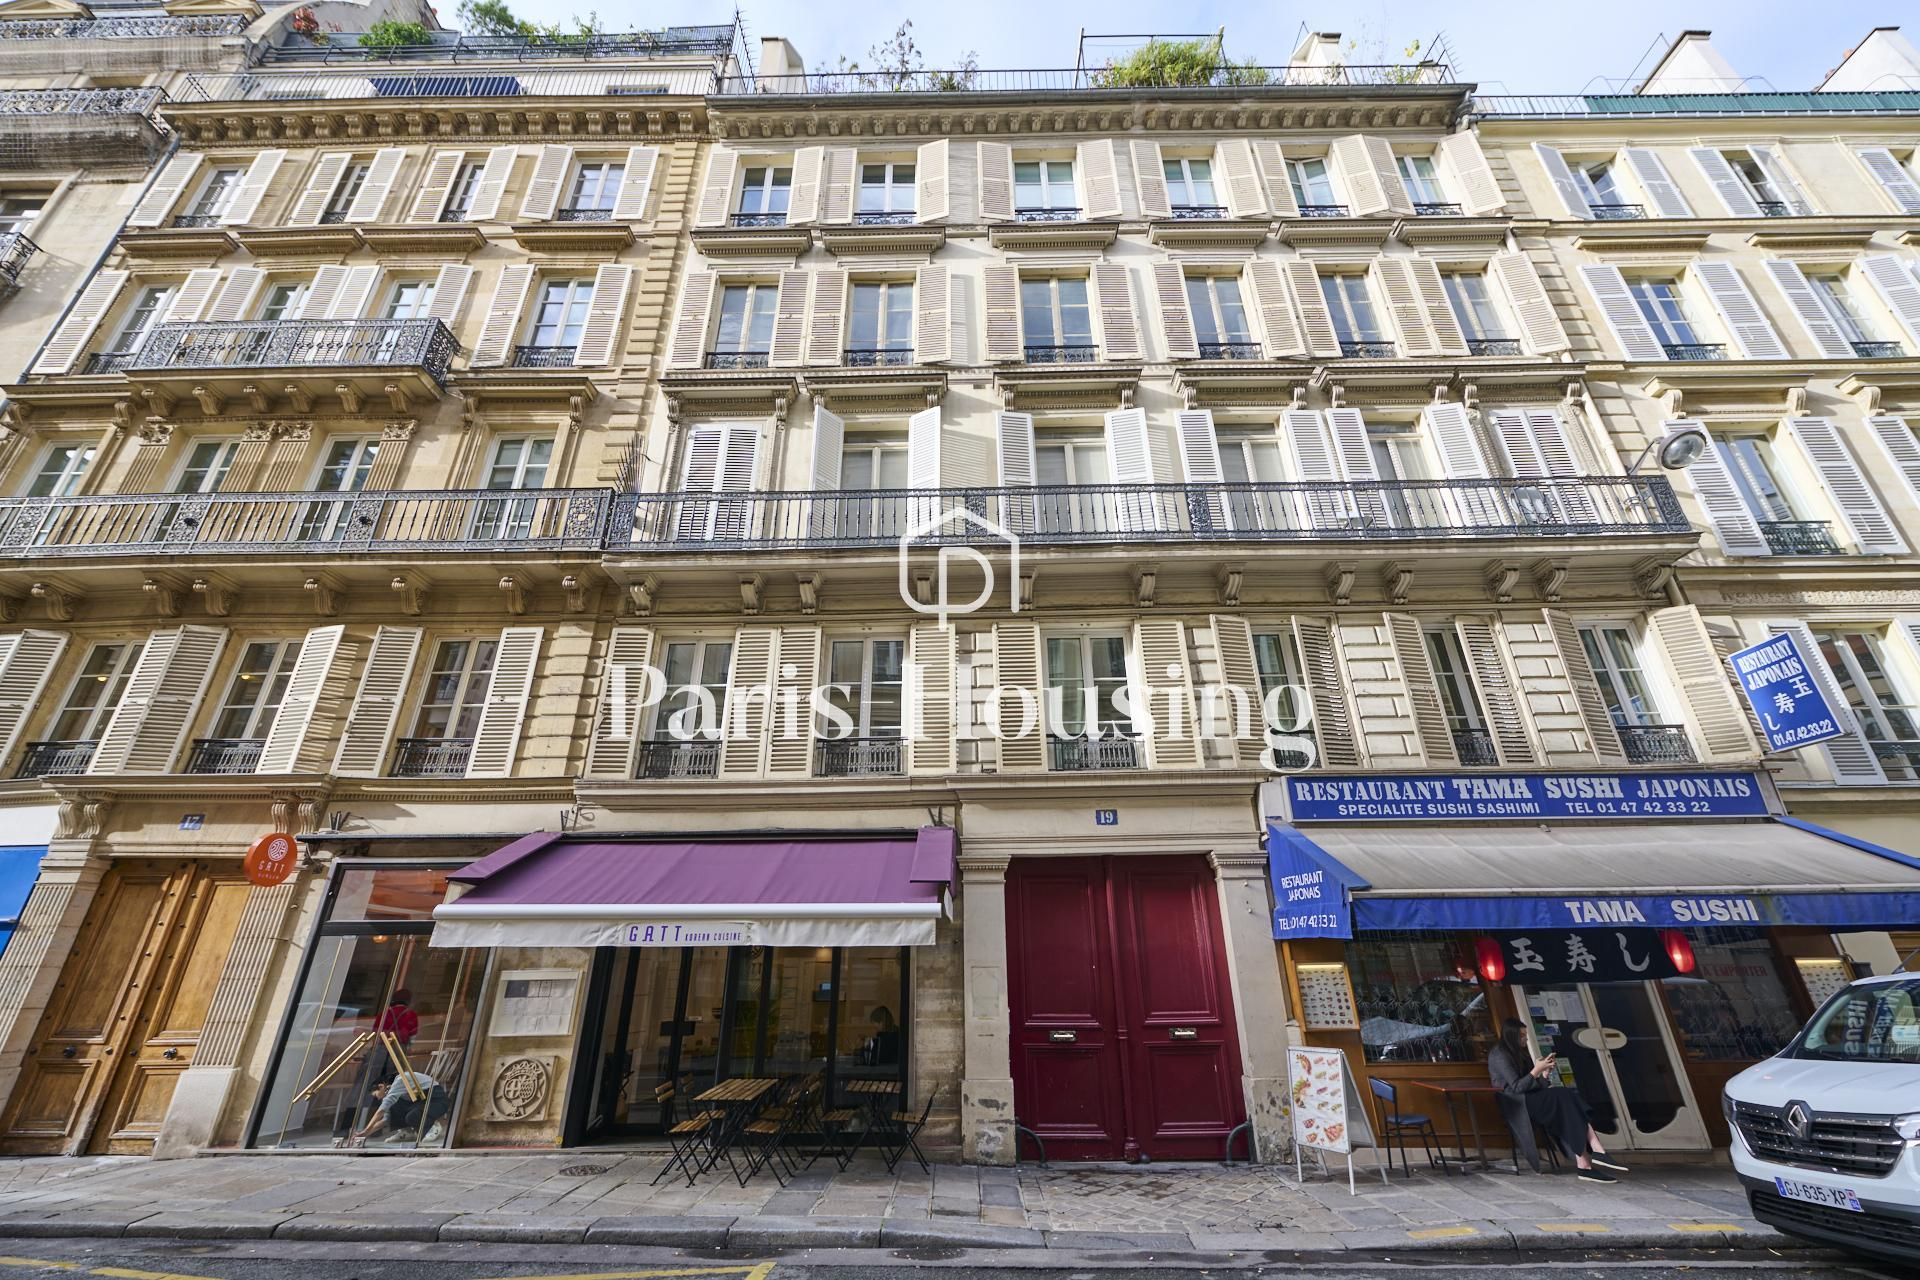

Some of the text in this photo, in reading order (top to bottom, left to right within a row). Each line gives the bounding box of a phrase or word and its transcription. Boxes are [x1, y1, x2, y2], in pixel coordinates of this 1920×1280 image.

[1736, 639, 1793, 674] RESTAURANT
[1746, 656, 1803, 691] JAPONAIS
[1763, 675, 1814, 731] 玉寿し
[1294, 777, 1751, 801] RESTAURANT TAMA SUSHI JAPONAIS
[1100, 811, 1114, 824] 19
[1338, 801, 1711, 816] SPECIALITE SUSHI SASHIMI TEL 01 47 42 33 22
[183, 816, 200, 828] 17
[1281, 870, 1323, 889] RESTAURANT
[1288, 886, 1321, 902] JAPONAIS
[1565, 899, 1760, 923] TAMA SUSHI
[629, 925, 682, 942] GATT
[713, 932, 742, 941] CUISINE
[1509, 931, 1651, 974] 玉寿し
